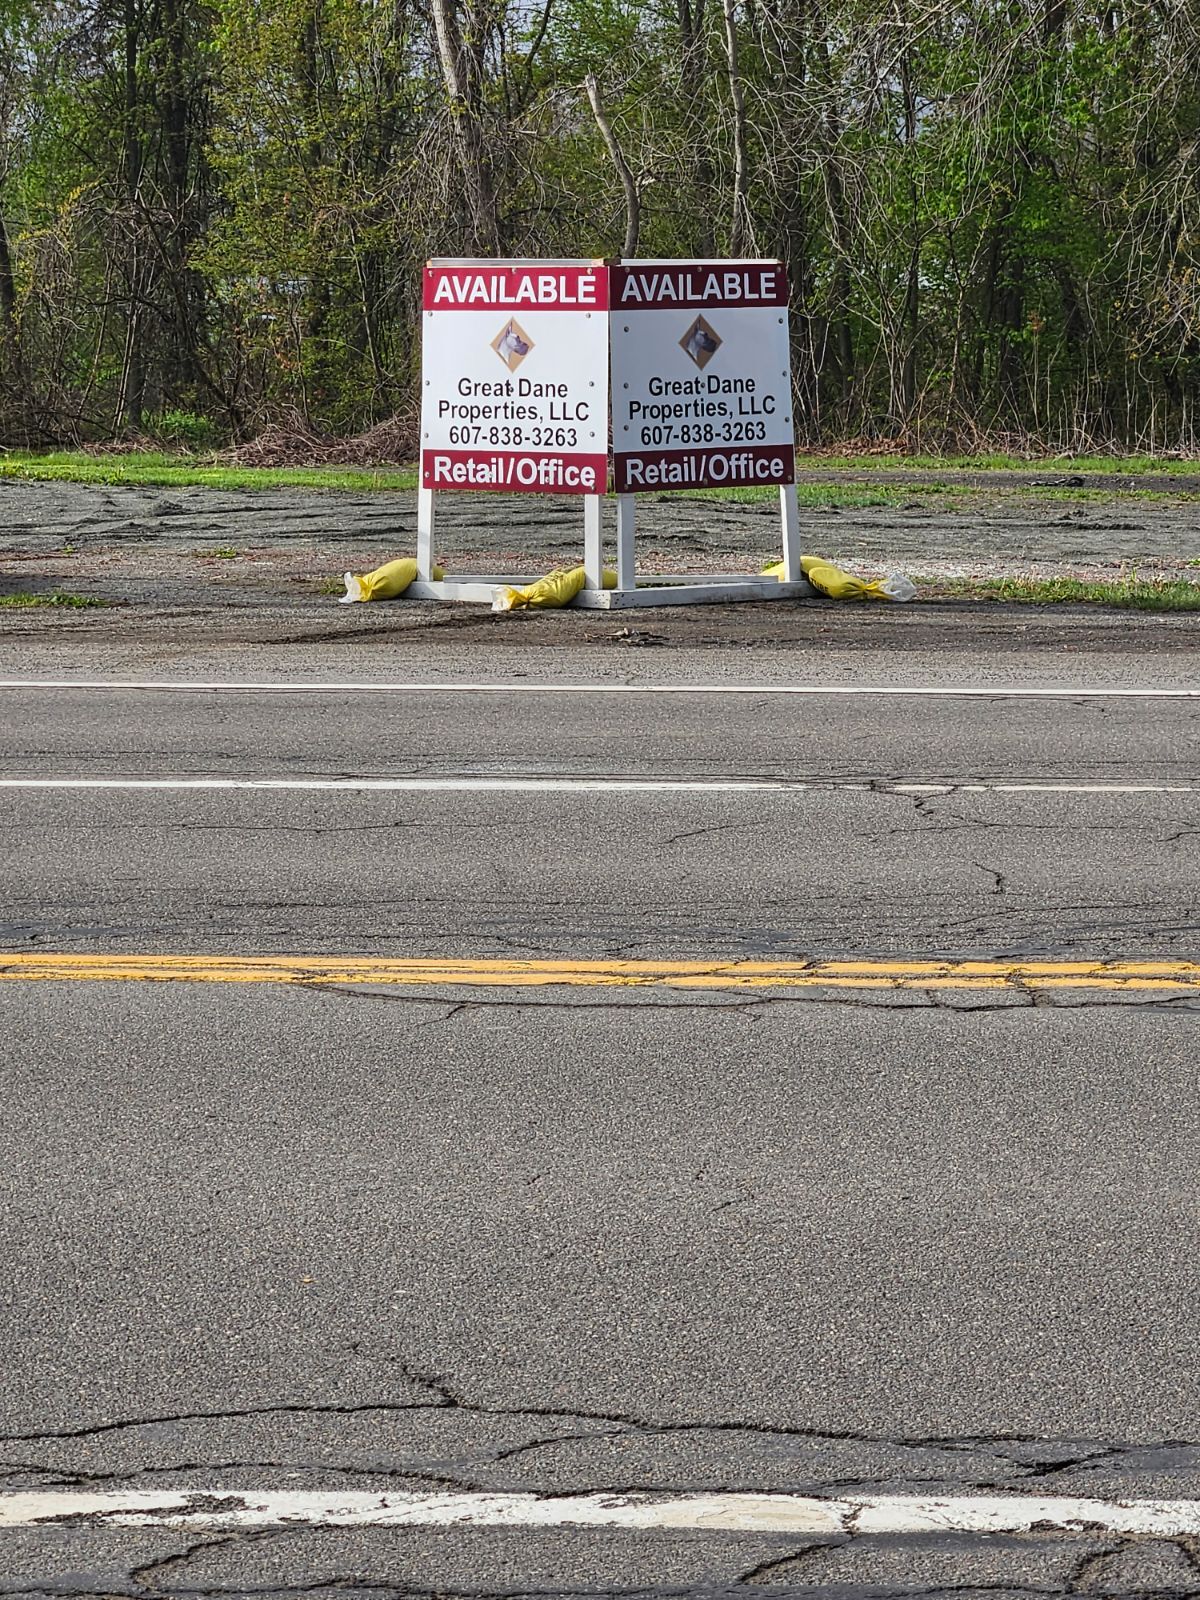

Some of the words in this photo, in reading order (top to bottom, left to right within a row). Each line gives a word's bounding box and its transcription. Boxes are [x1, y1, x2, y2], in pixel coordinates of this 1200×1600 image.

[433, 275, 597, 304] AVAILABLE
[621, 272, 777, 302] AVAILABLE
[457, 377, 512, 397] Great
[518, 378, 568, 398] Dane
[648, 376, 701, 397] Great
[707, 374, 756, 394] Dane
[438, 400, 543, 424] Properties,
[549, 402, 590, 422] LLC
[629, 398, 734, 424] Properties,
[738, 395, 776, 416] LLC
[449, 426, 578, 447] 607-838-3263
[640, 421, 767, 446] 607-838-3263
[433, 456, 596, 487] Retail/Office
[626, 453, 784, 485] Retail/Office
